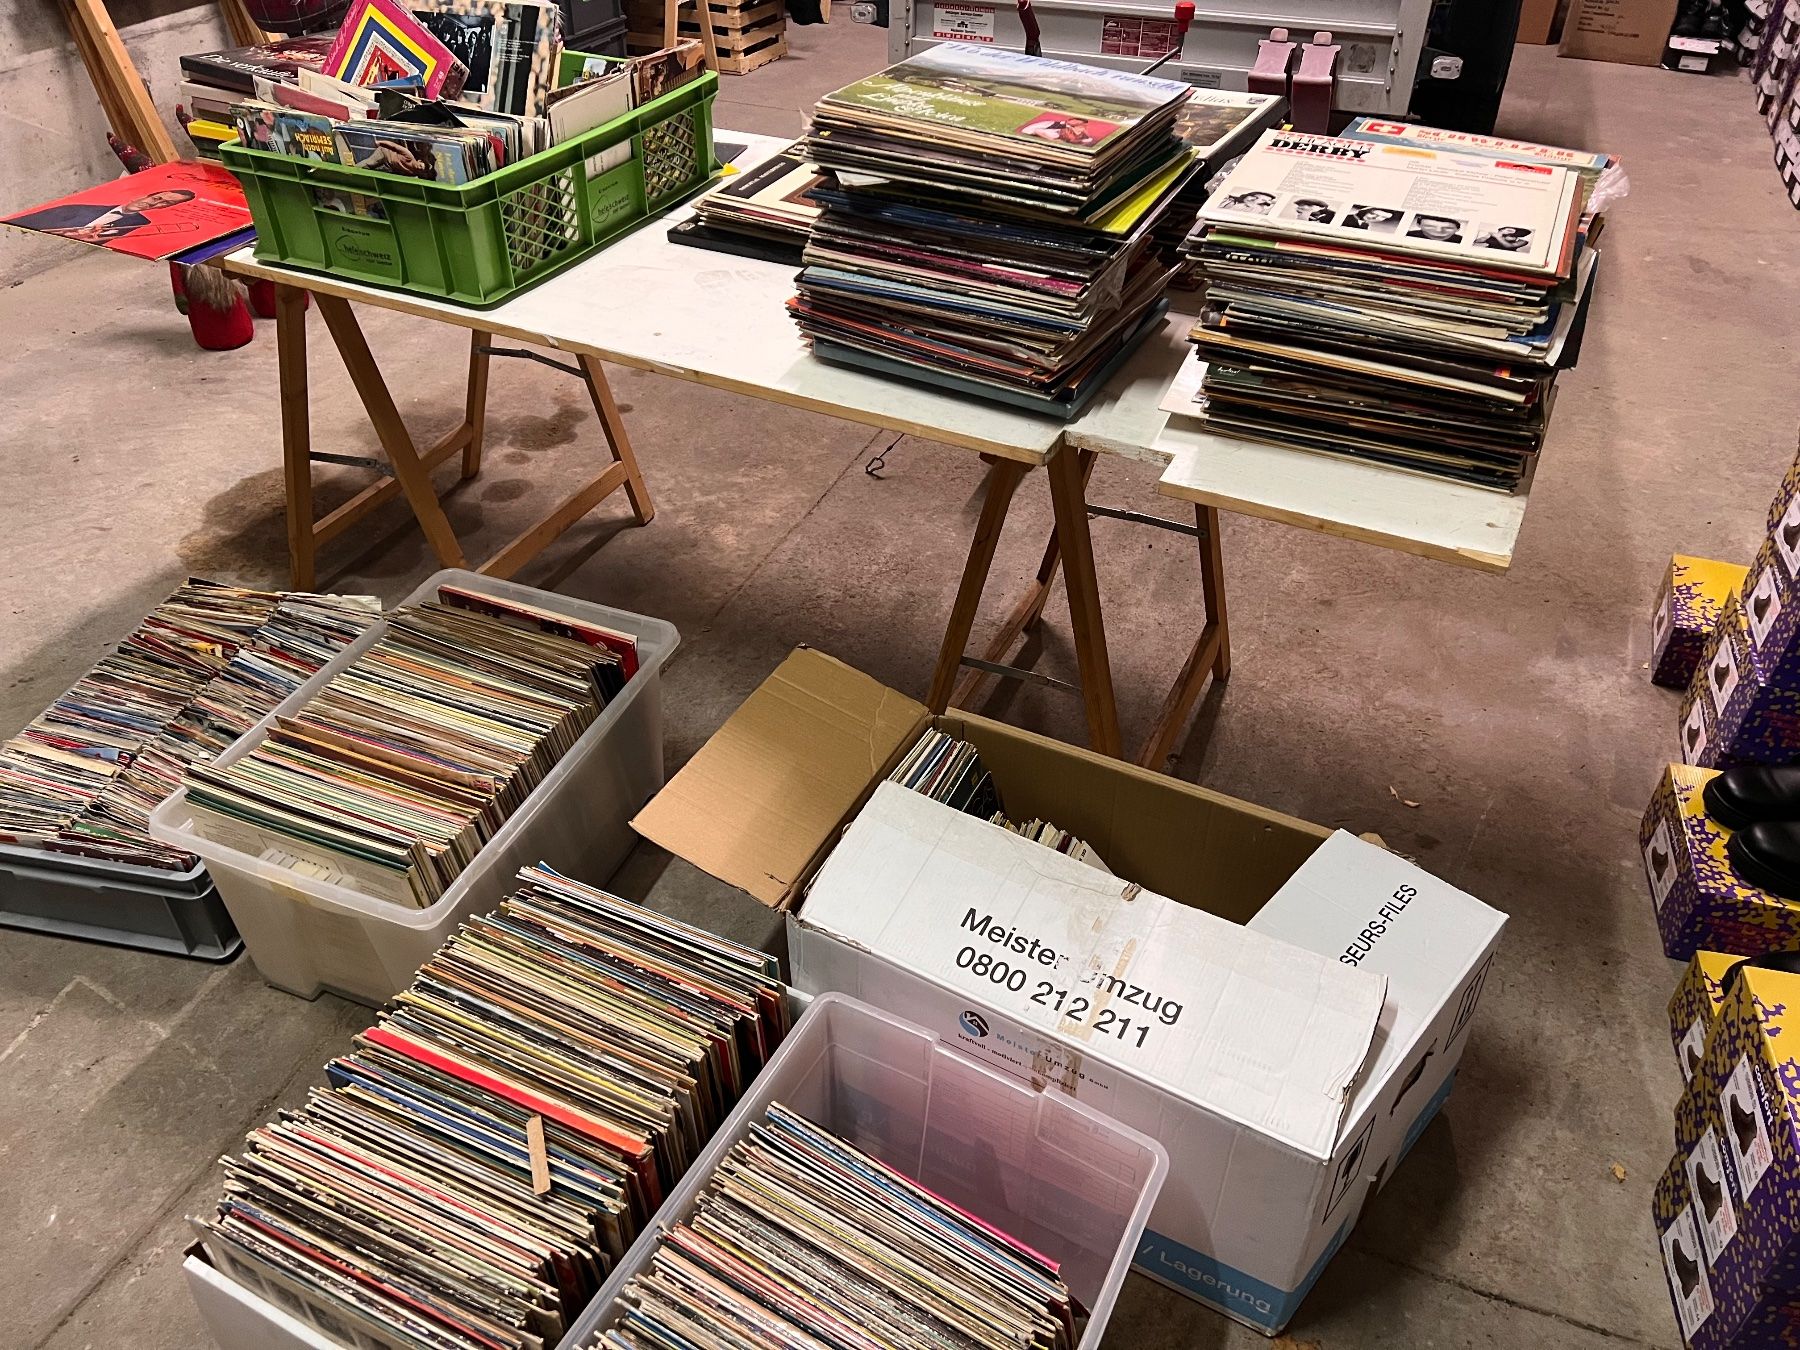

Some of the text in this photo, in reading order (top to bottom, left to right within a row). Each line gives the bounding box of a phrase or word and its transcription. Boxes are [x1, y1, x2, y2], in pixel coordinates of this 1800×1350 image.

[1268, 138, 1372, 159] DERBY
[955, 946, 1151, 1049] 0800 212 211
[1079, 964, 1184, 1026] mzug
[957, 1033, 986, 1050] kraftvoll
[991, 1049, 1022, 1066] motiviert
[1045, 1055, 1086, 1079] Umzug
[1755, 1064, 1774, 1127] comfort
[1720, 1137, 1738, 1199] comfort
[1160, 1250, 1271, 1314] Lagerung
